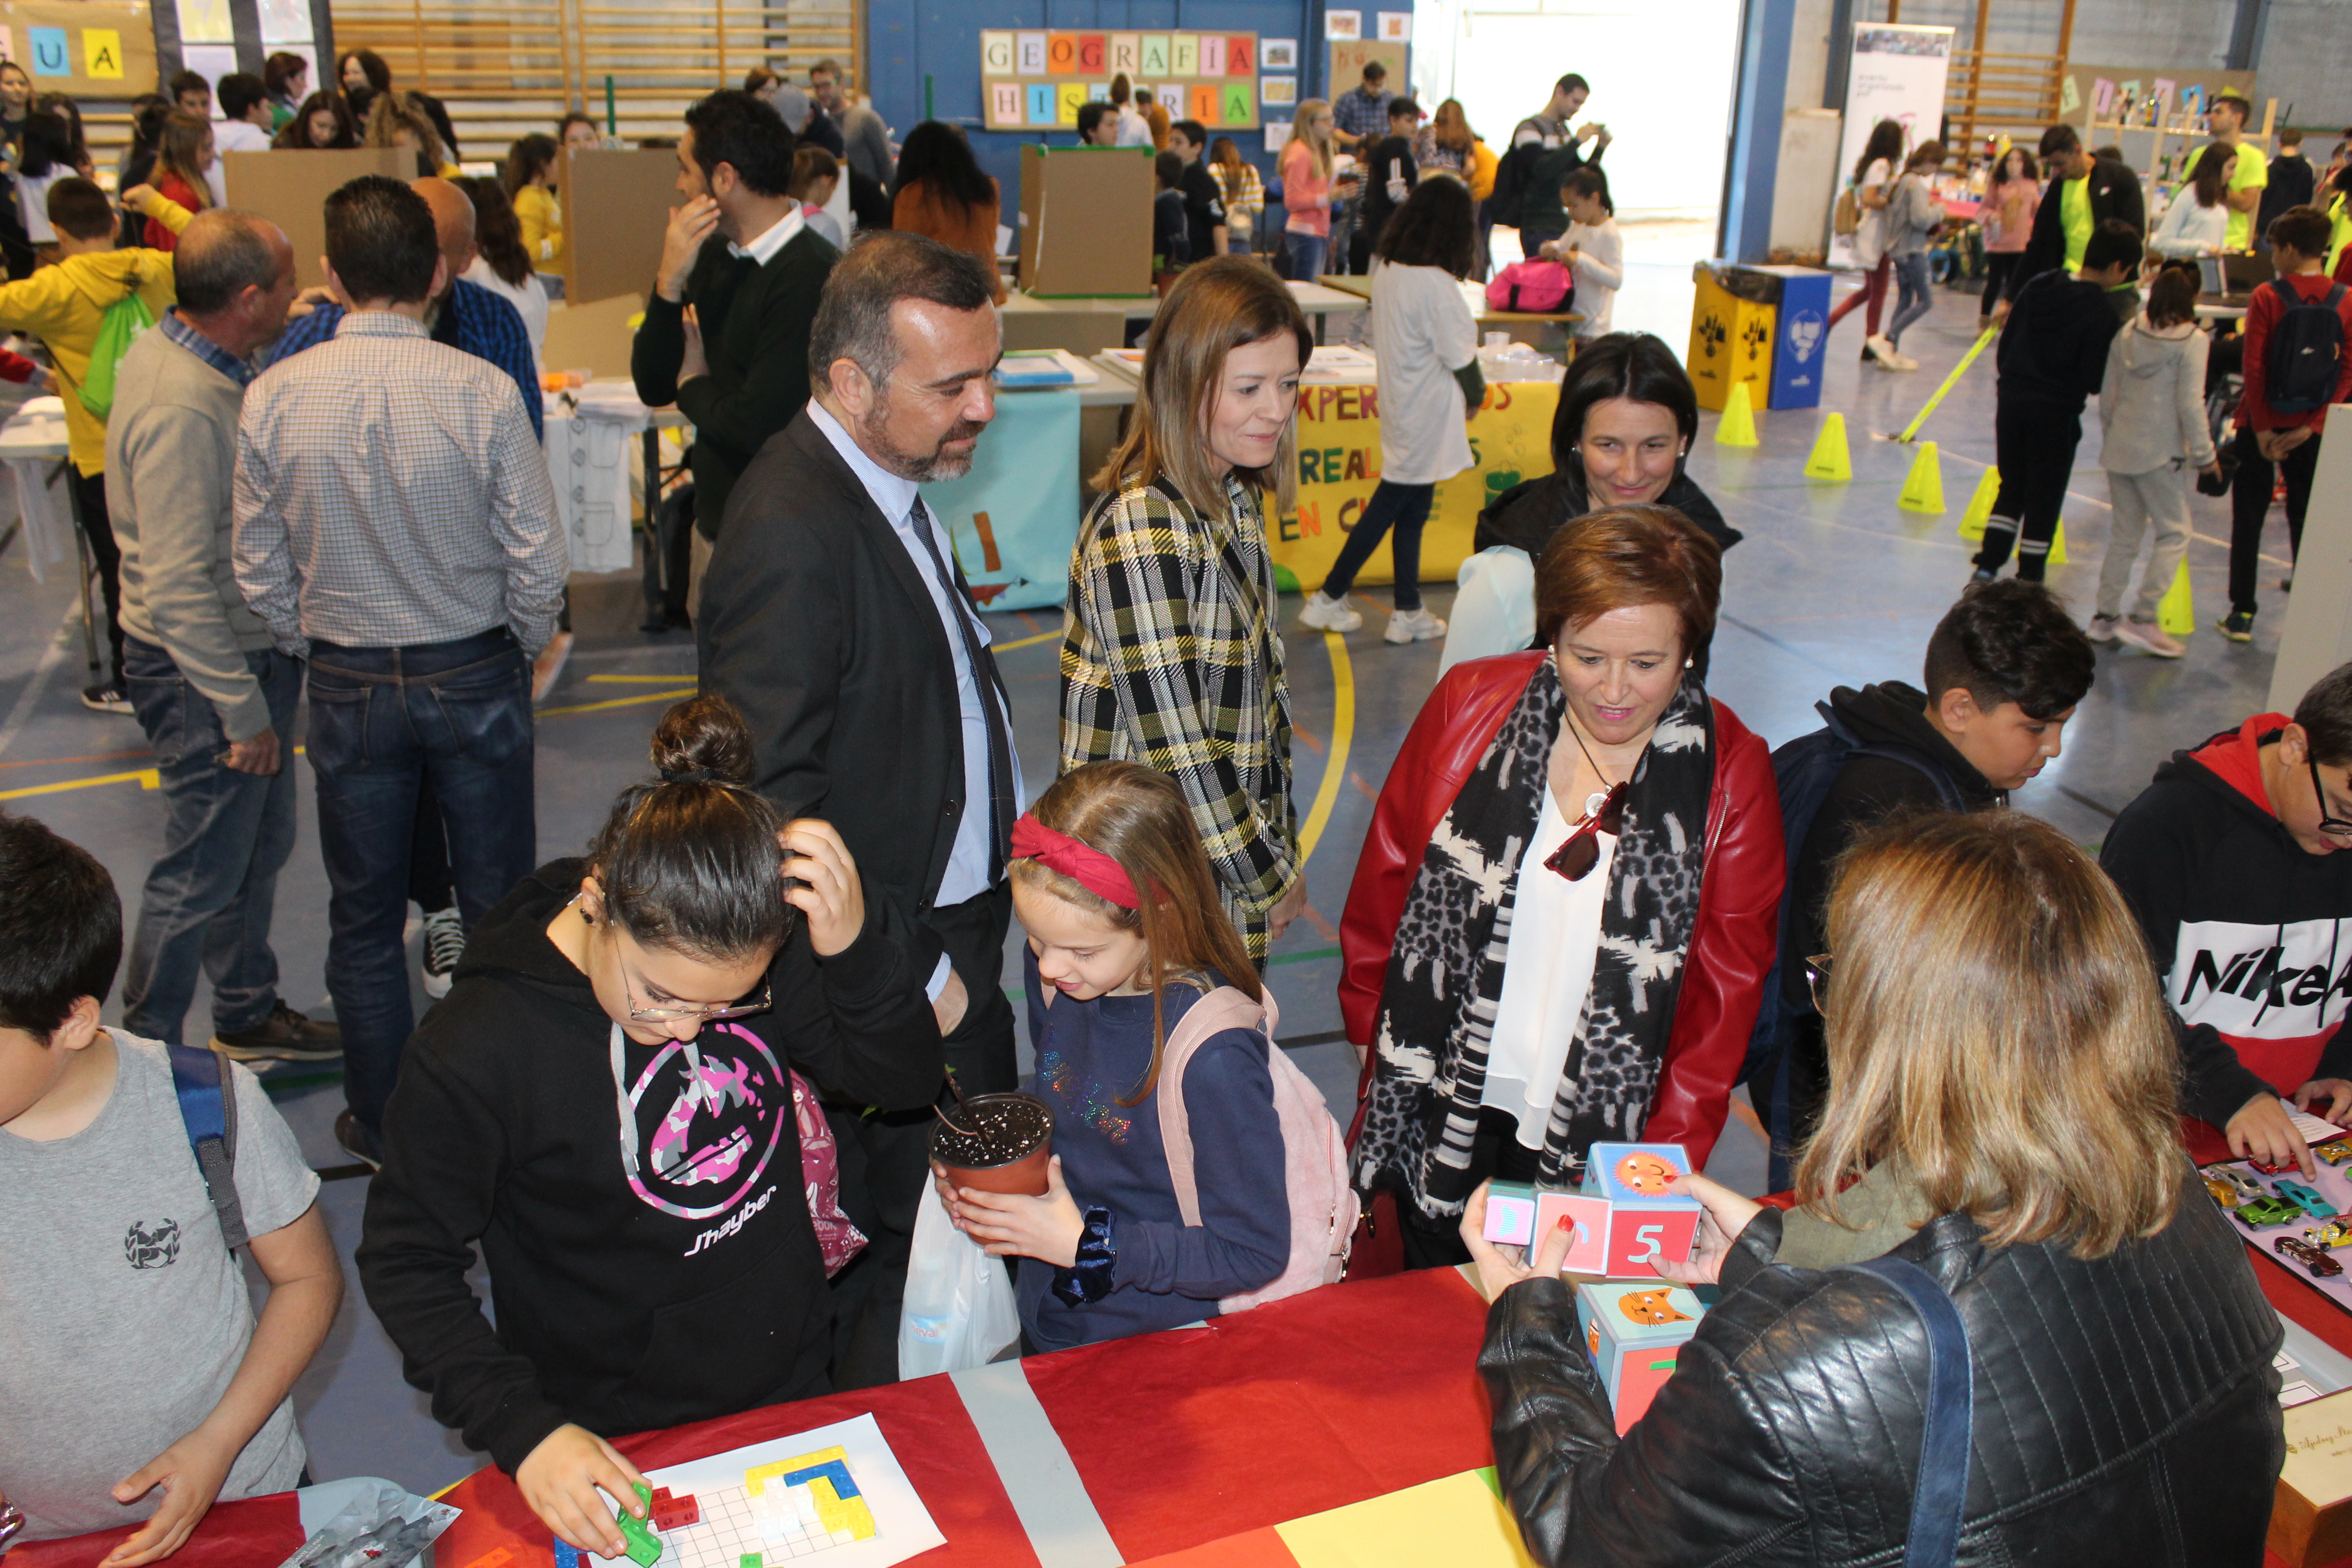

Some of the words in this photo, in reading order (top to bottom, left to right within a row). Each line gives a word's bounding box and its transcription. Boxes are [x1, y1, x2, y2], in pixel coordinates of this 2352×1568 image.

[988, 39, 1249, 69] GEOGRAFÍA
[997, 89, 1247, 117] HISRIA
[684, 1185, 777, 1257] J'hayber
[1627, 1225, 1664, 1264] 5
